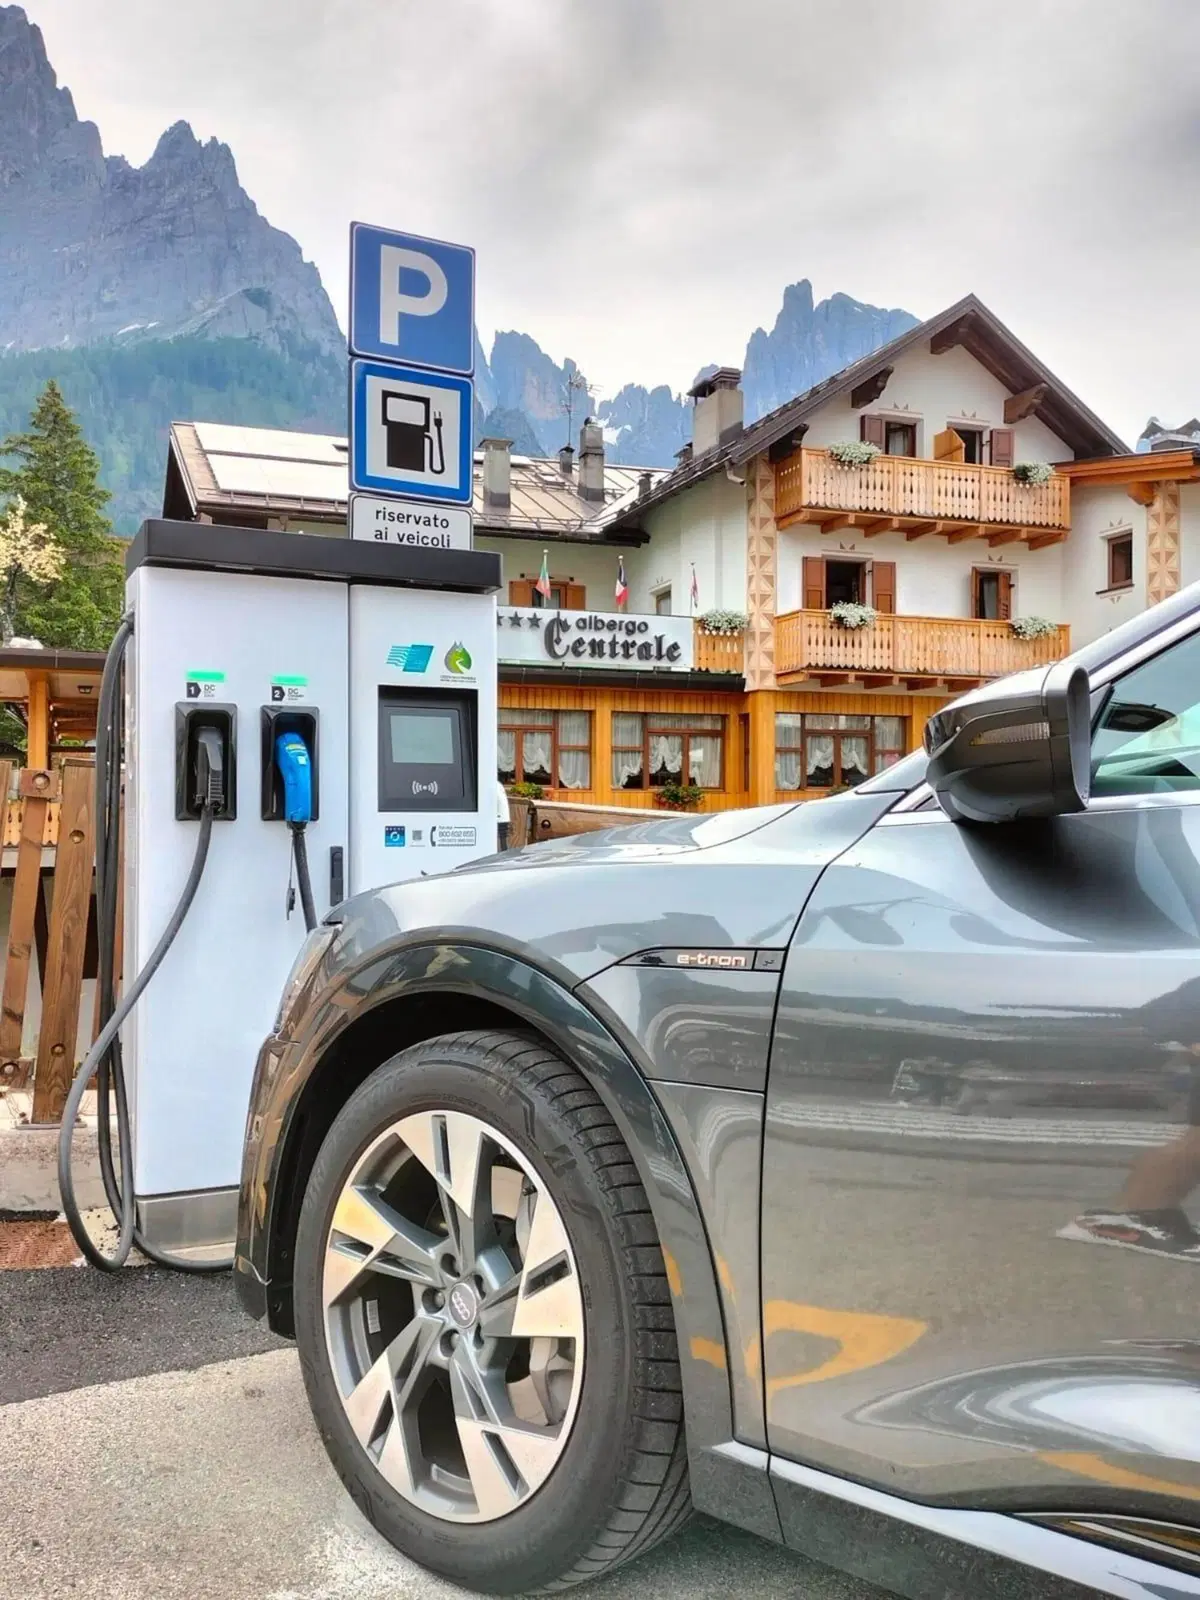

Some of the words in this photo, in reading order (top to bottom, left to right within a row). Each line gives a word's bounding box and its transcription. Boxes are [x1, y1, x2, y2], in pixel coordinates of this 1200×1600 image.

[379, 243, 448, 346] P
[375, 506, 450, 529] riservato
[374, 526, 389, 541] ai
[397, 530, 451, 548] veicoli
[543, 610, 683, 663] Centrale
[575, 615, 650, 637] albergo
[287, 687, 299, 695] DC
[676, 952, 747, 967] e-tron
